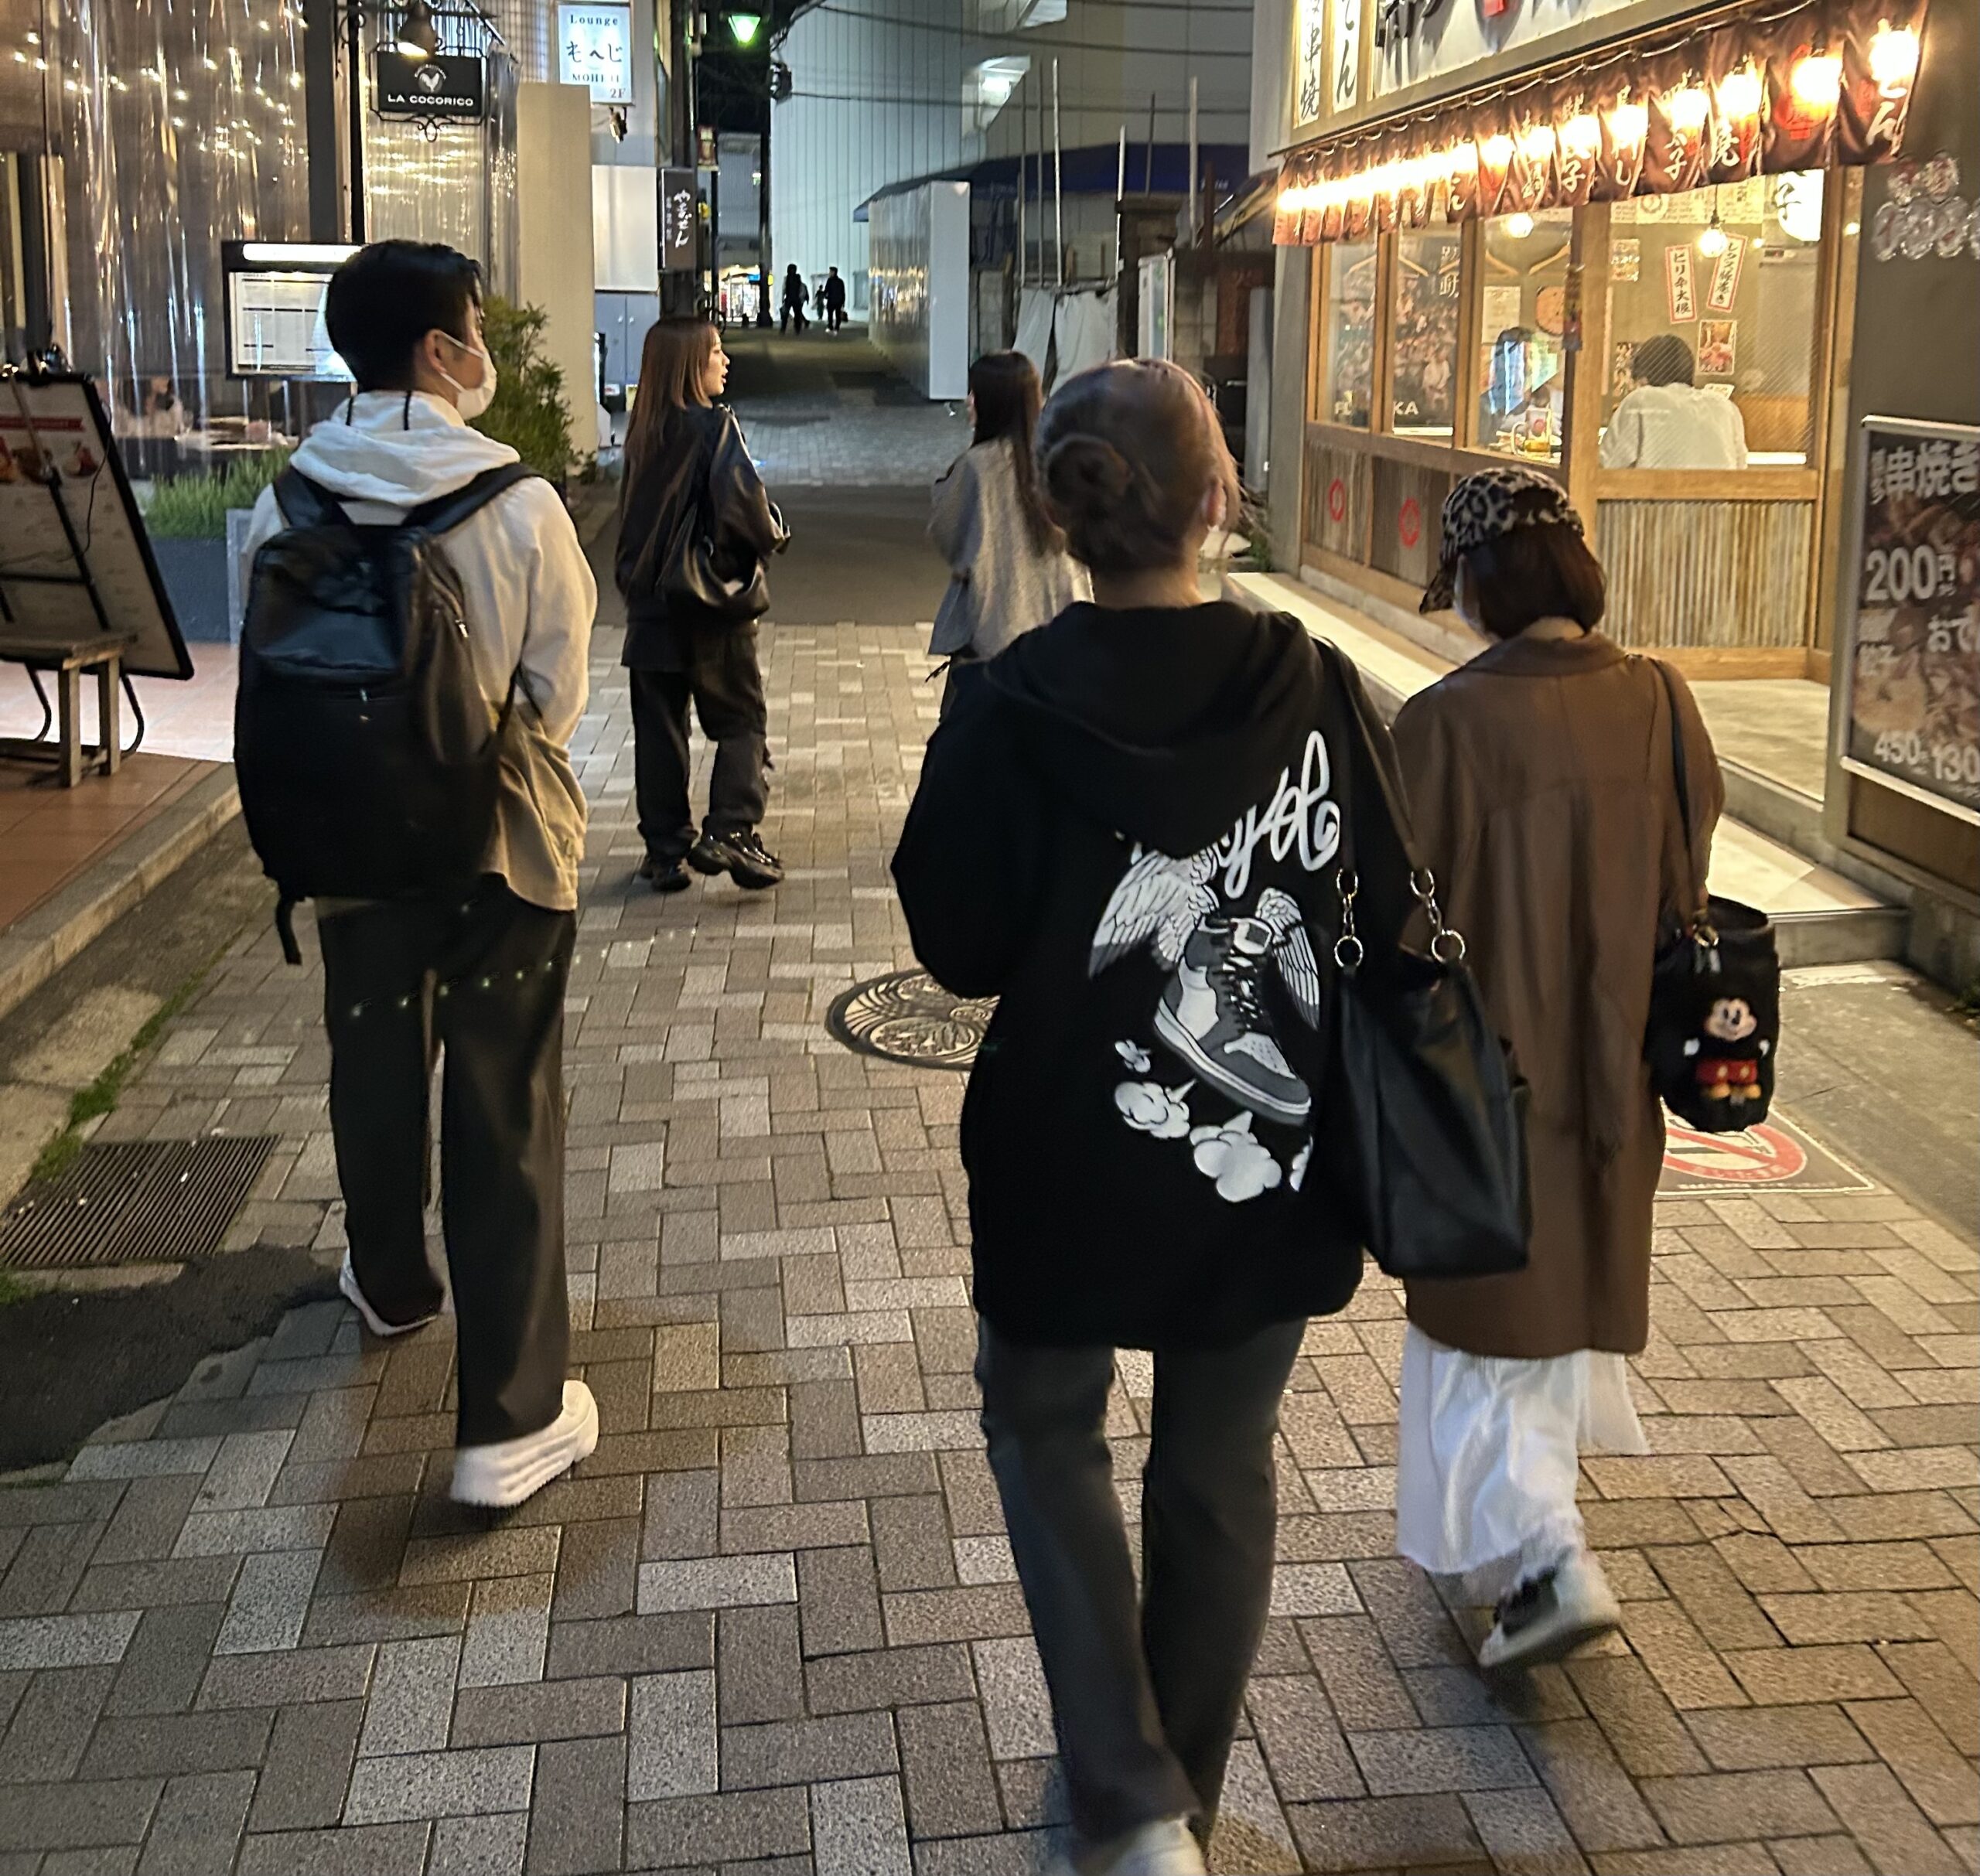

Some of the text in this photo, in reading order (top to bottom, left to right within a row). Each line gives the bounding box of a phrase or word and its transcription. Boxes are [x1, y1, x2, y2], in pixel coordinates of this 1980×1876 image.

[570, 14, 619, 26] Lounge
[565, 40, 623, 63] もへじ
[609, 87, 626, 99] 2F
[387, 94, 473, 107] LA COCORICO
[1886, 439, 1979, 501] 串焼き
